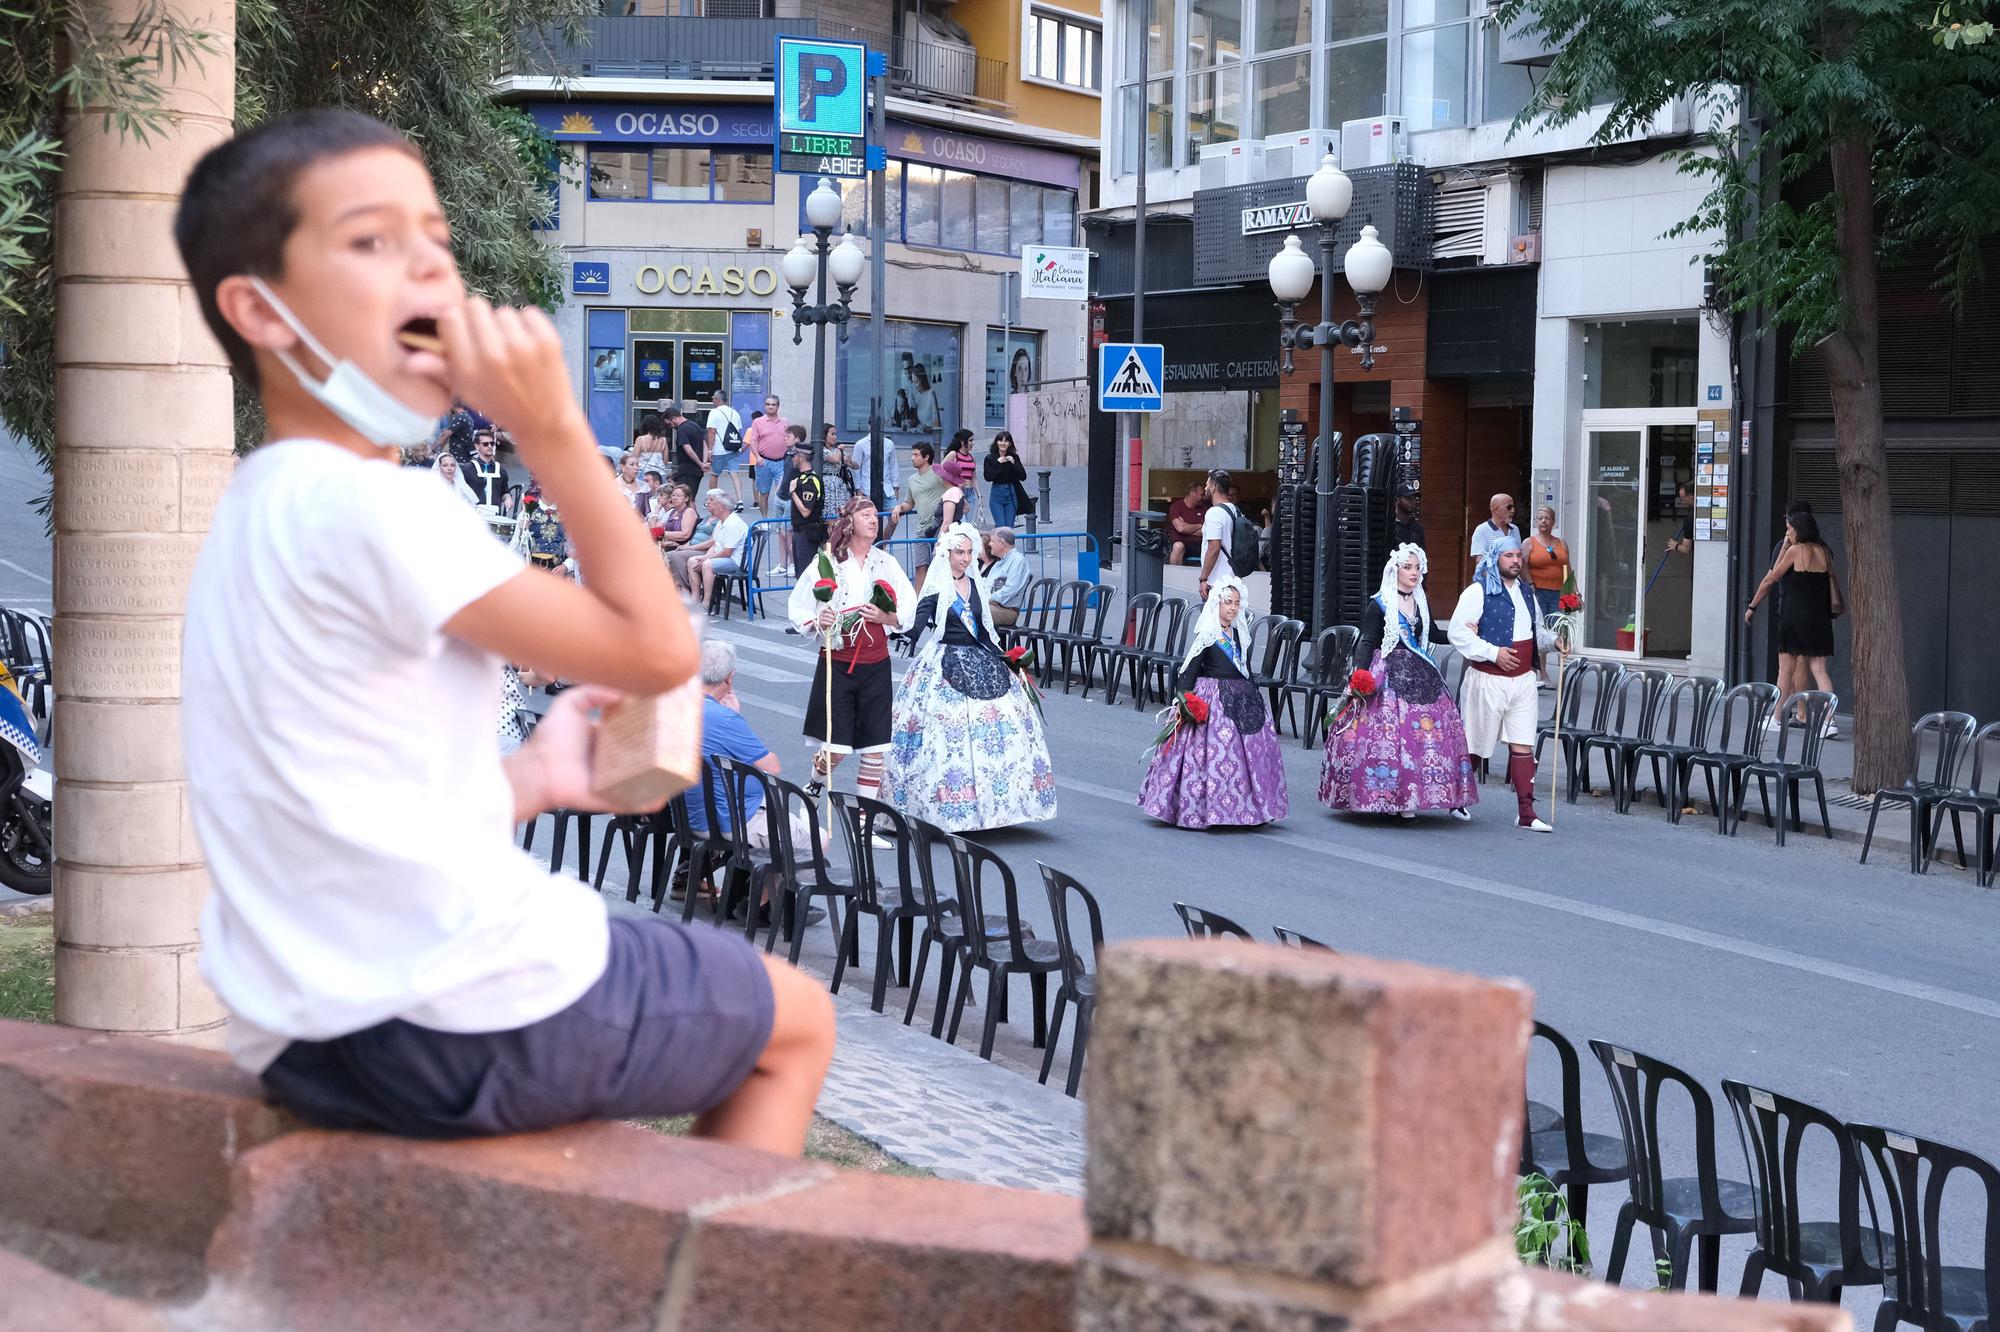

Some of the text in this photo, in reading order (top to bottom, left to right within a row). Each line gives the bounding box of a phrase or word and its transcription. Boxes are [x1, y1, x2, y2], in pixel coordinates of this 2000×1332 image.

[798, 52, 847, 122] P
[615, 112, 719, 136] OCASO
[791, 135, 852, 156] LIBRE
[933, 136, 1026, 173] OCASO SEGUROS
[1244, 204, 1314, 229] RAMAZZO
[636, 264, 778, 295] OCASO
[1032, 268, 1084, 284] Italiana
[1059, 265, 1084, 275] Cocina
[1163, 356, 1280, 380] ESTAURANTE CAFETERÍA
[1710, 388, 1720, 398] 44
